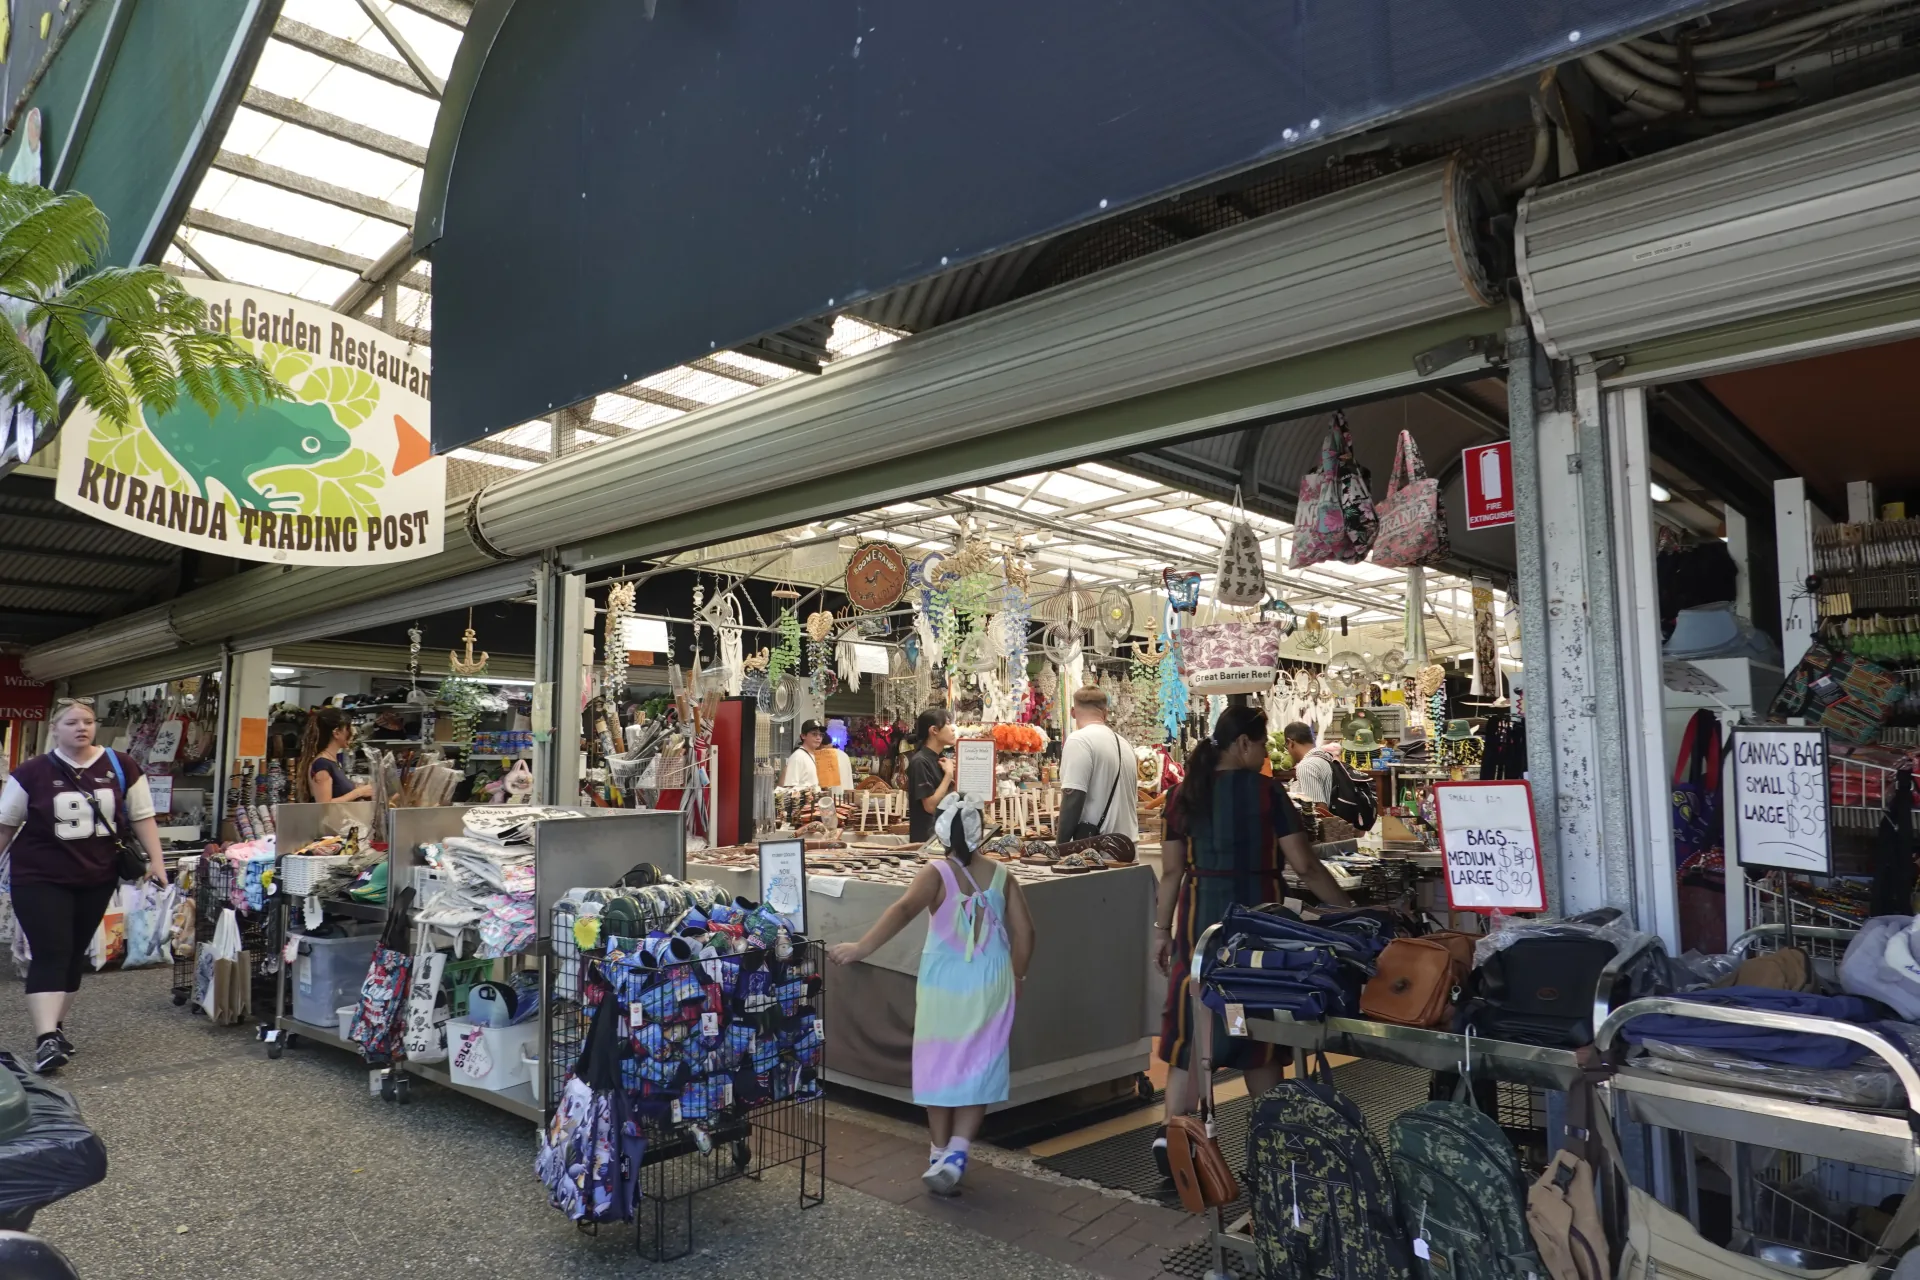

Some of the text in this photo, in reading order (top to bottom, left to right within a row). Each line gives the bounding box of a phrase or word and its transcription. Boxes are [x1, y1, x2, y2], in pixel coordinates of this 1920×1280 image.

[243, 298, 321, 355] Garden
[78, 457, 429, 552] KURANDA TRADING POST
[1486, 502, 1502, 511] FIRE
[4, 675, 45, 688] Wines
[1195, 670, 1271, 683] Great Barrier Reef
[1739, 741, 1789, 765] CANVAS
[1746, 775, 1785, 795] SMALL
[53, 788, 117, 841] 91
[1745, 804, 1786, 824] LARGE
[1448, 850, 1496, 867] MEDIUM
[1451, 869, 1494, 886] LARGE
